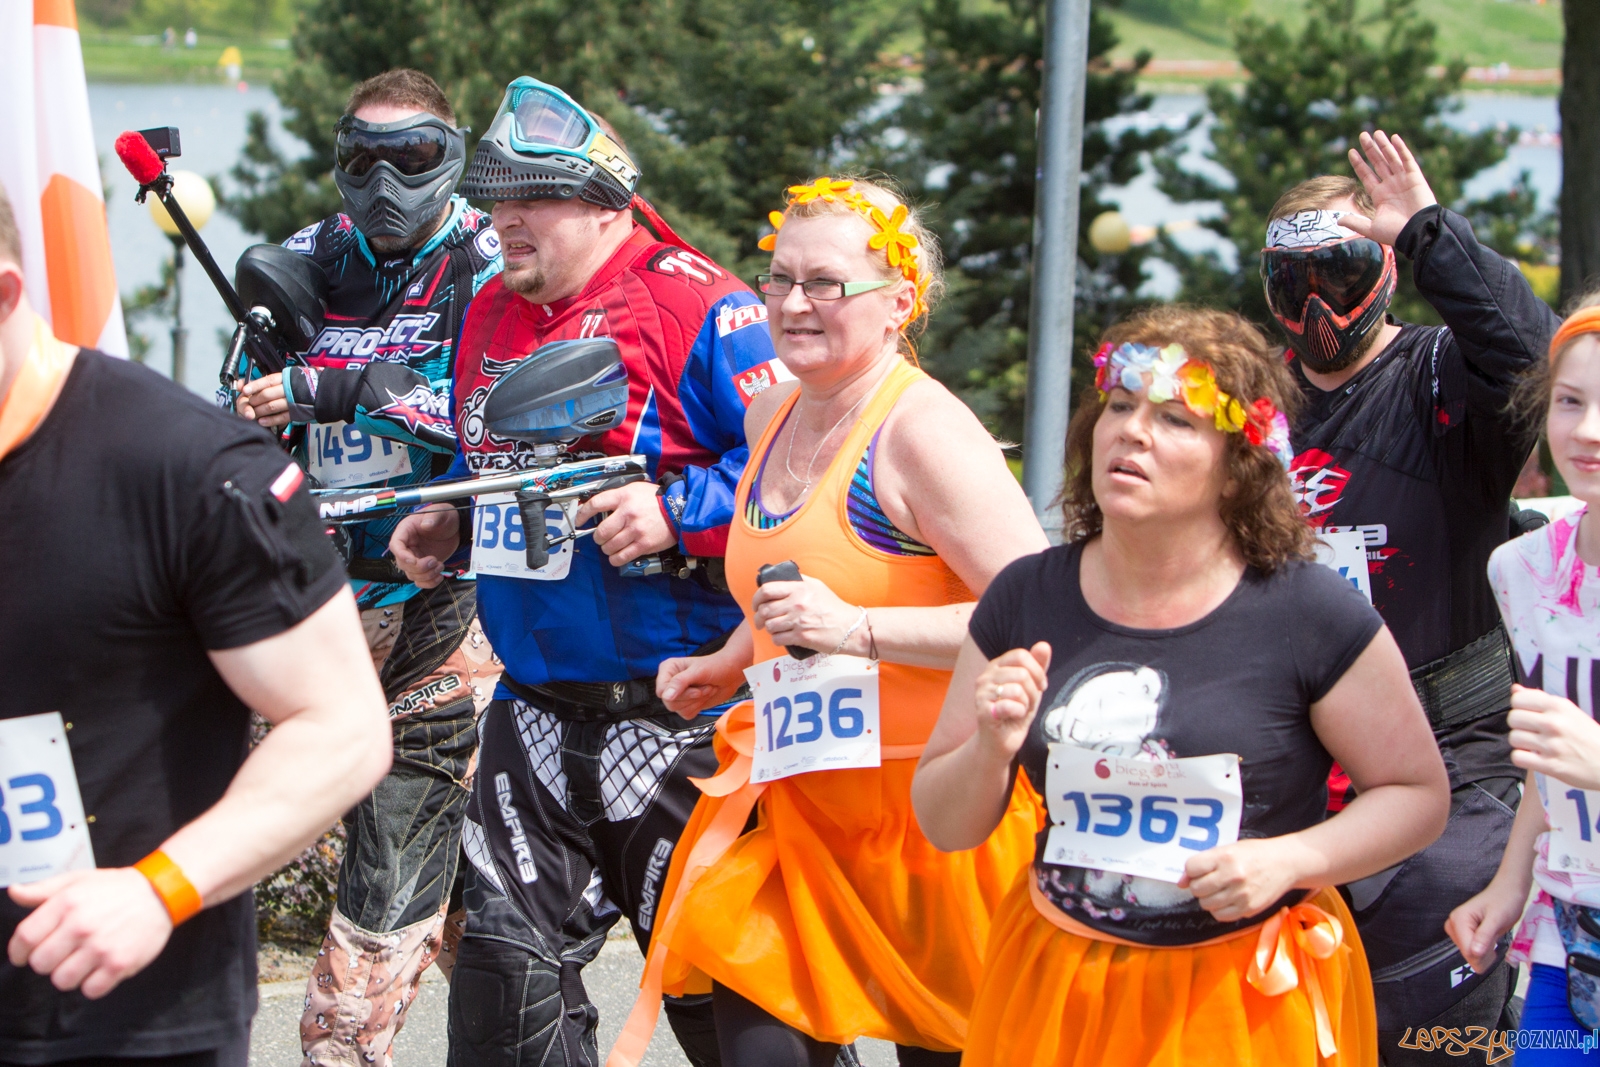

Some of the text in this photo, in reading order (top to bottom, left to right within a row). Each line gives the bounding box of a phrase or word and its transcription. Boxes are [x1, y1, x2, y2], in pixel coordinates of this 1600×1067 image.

[320, 494, 377, 519] NHP
[763, 688, 864, 752] 1236
[1115, 760, 1150, 780] bieg
[1063, 791, 1224, 851] 1363
[1565, 789, 1600, 842] 1
